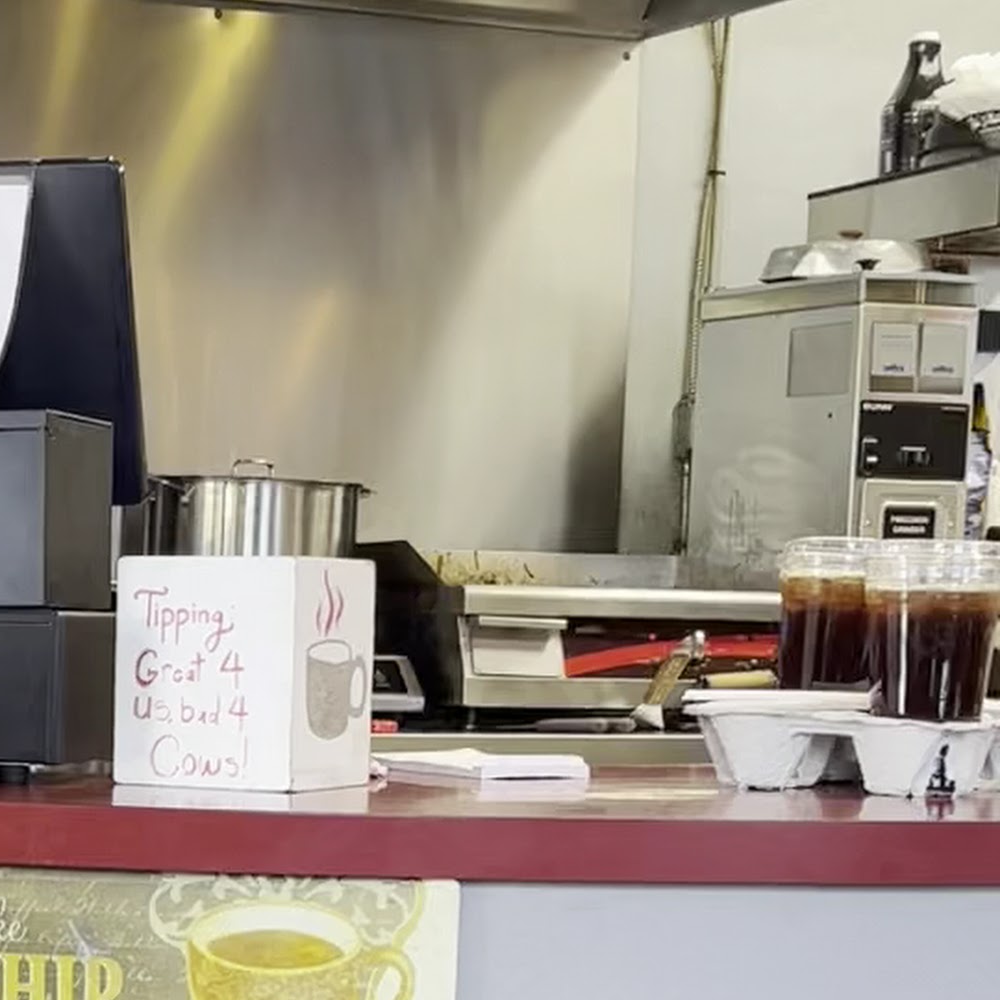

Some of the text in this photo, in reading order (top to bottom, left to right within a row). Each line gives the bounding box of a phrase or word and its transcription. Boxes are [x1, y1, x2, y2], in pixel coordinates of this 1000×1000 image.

[134, 648, 244, 690] Great 4
[180, 695, 221, 725] bad
[228, 696, 249, 731] 4
[150, 734, 249, 779] Cows!
